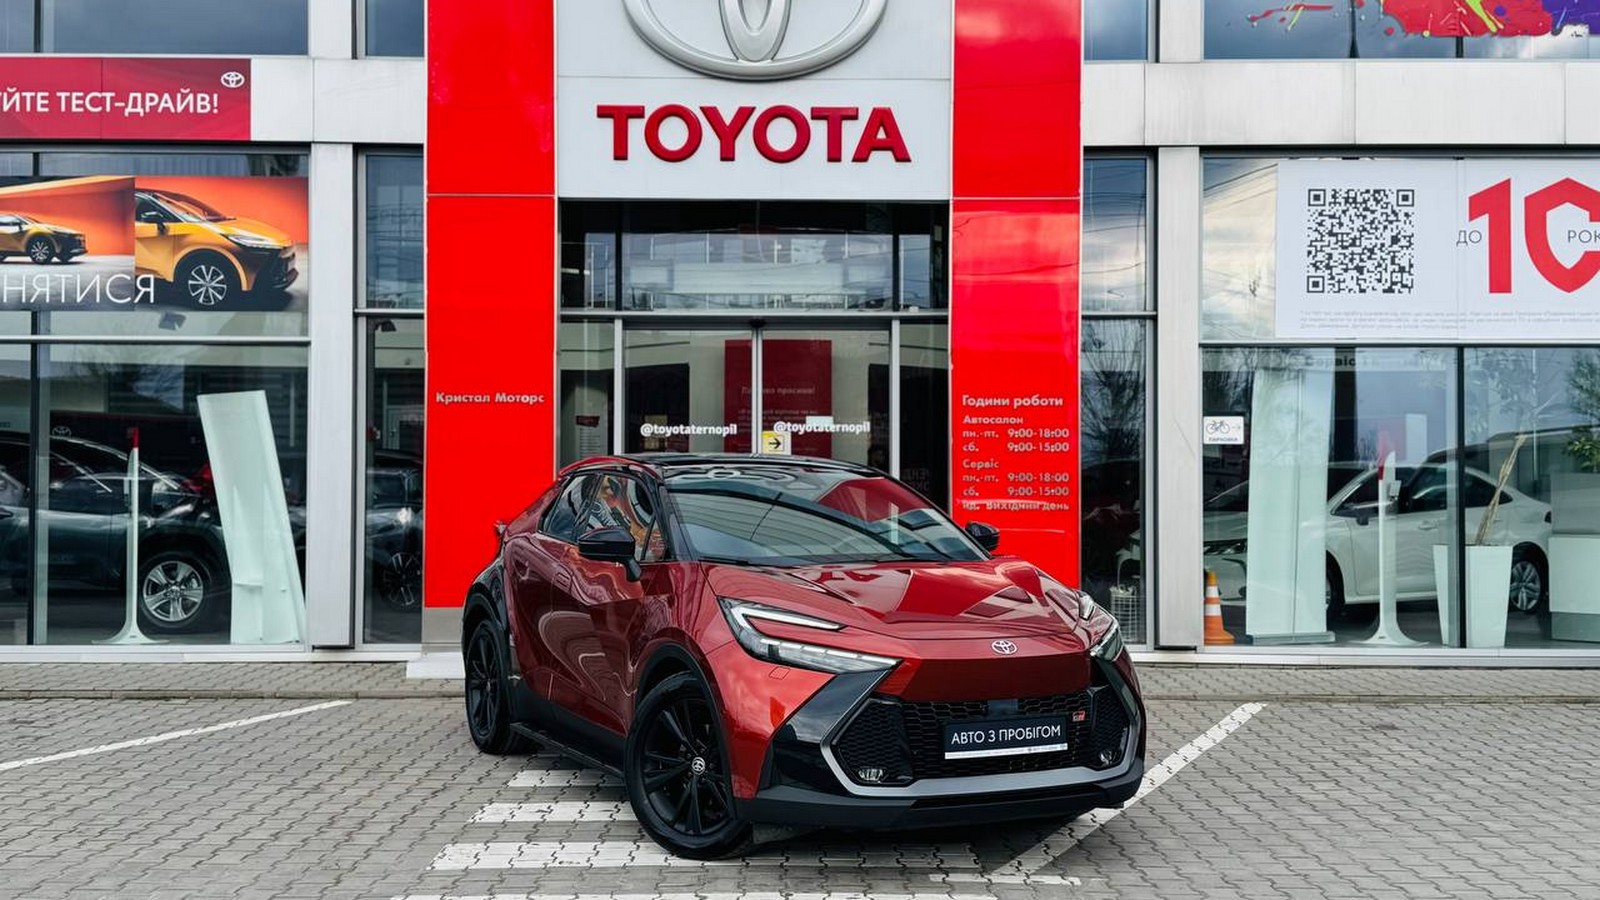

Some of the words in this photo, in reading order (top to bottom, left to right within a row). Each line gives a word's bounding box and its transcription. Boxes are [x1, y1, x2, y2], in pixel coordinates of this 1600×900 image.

[0, 87, 50, 112] ЙТЕ
[56, 88, 219, 117] ТЕСТ-ДРАЙВ!
[597, 104, 912, 163] TOYOTA
[1456, 230, 1482, 247] ДО
[3, 274, 155, 304] НЯТИСЯ
[436, 392, 490, 405] Кристал
[495, 392, 545, 405] Моторс
[962, 395, 1010, 407] Години
[1013, 394, 1064, 409] роботи
[962, 415, 1024, 425] Автосалон
[640, 423, 737, 437] @toyotaternopil
[773, 421, 870, 435] @toyotaternopil
[1007, 428, 1070, 438] 9:00-18:00
[962, 442, 980, 452] сб.
[1007, 442, 1070, 452] 9:00-15:00
[962, 458, 1000, 470] Сервіс
[1007, 473, 1070, 482] 9:00-18:00
[962, 486, 980, 496] сб.
[1007, 486, 1070, 496] 9:00-15:00
[1042, 502, 1069, 510] день
[951, 731, 985, 745] АВТО
[999, 724, 1061, 742] ПРОБІГОМ
